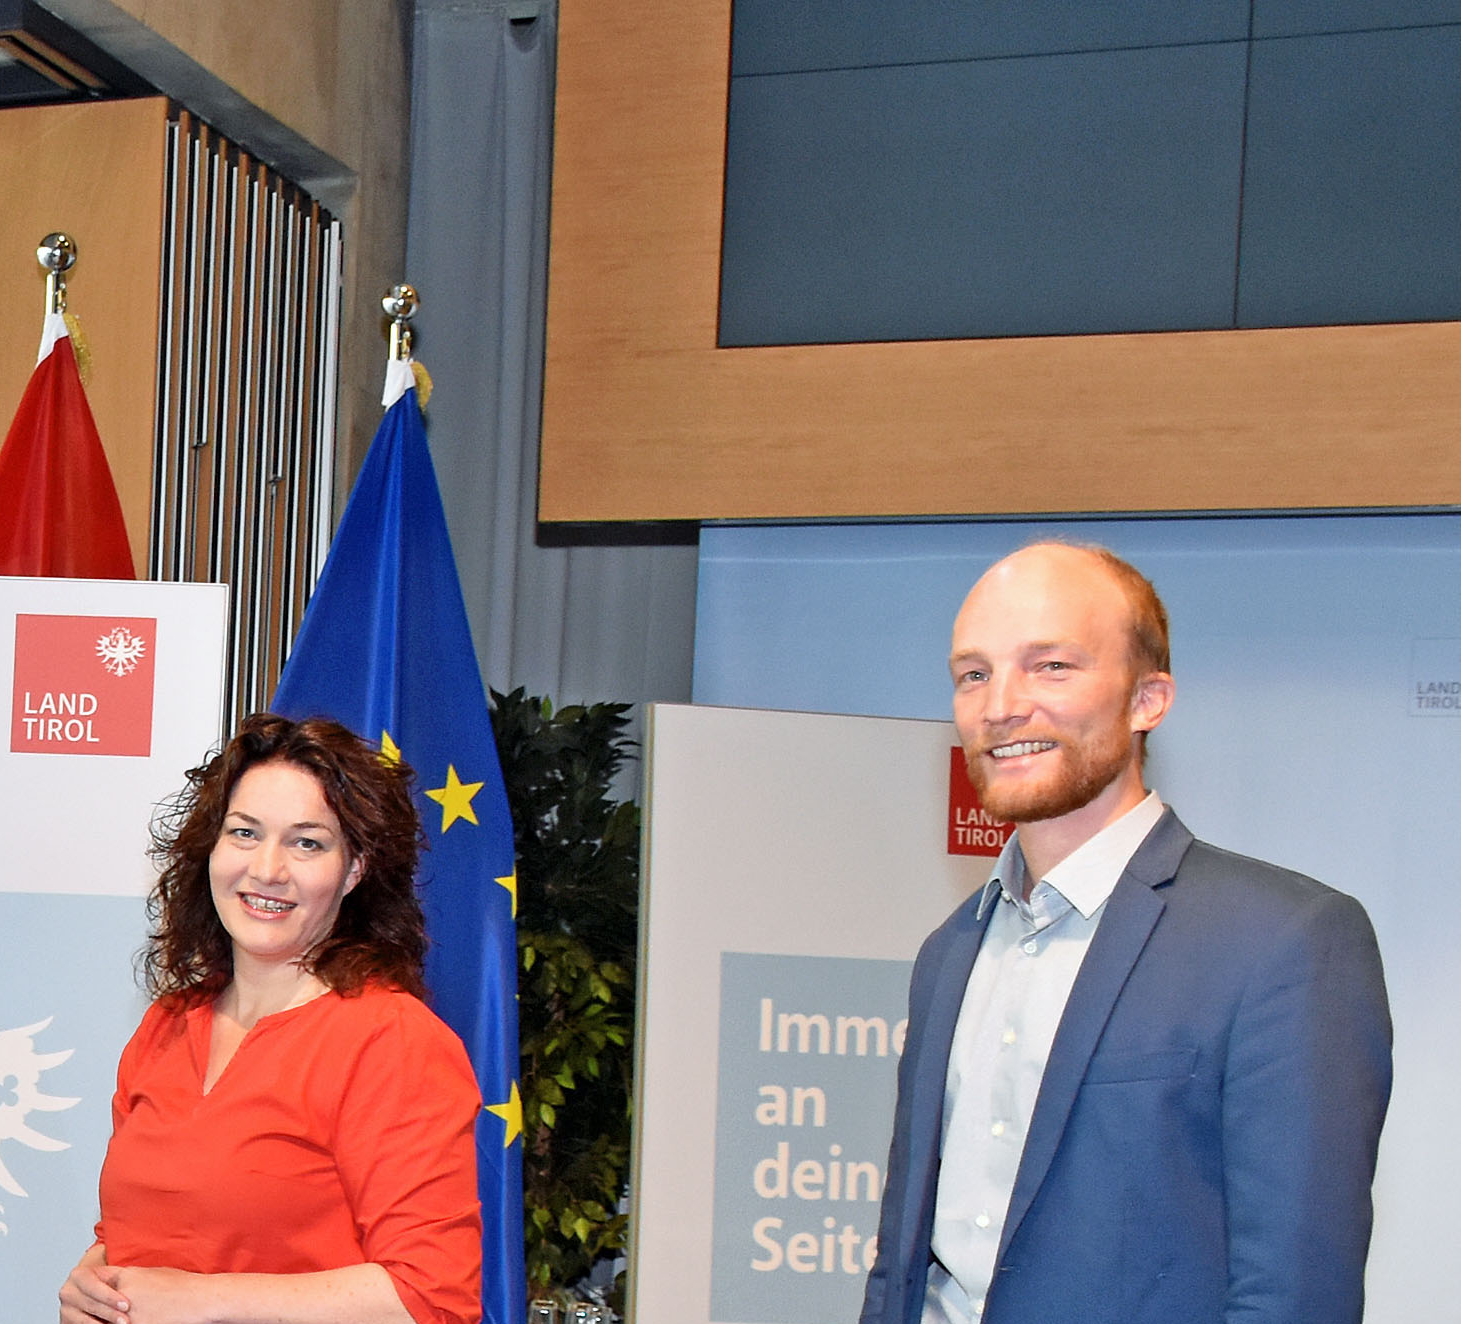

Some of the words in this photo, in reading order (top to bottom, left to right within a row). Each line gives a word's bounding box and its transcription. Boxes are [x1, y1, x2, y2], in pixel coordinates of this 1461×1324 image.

[1416, 681, 1461, 694] LAND
[23, 691, 98, 716] LAND
[22, 718, 100, 742] TIROL
[954, 827, 1006, 848] TIROL
[755, 1084, 827, 1128] an
[753, 1141, 887, 1202] dein
